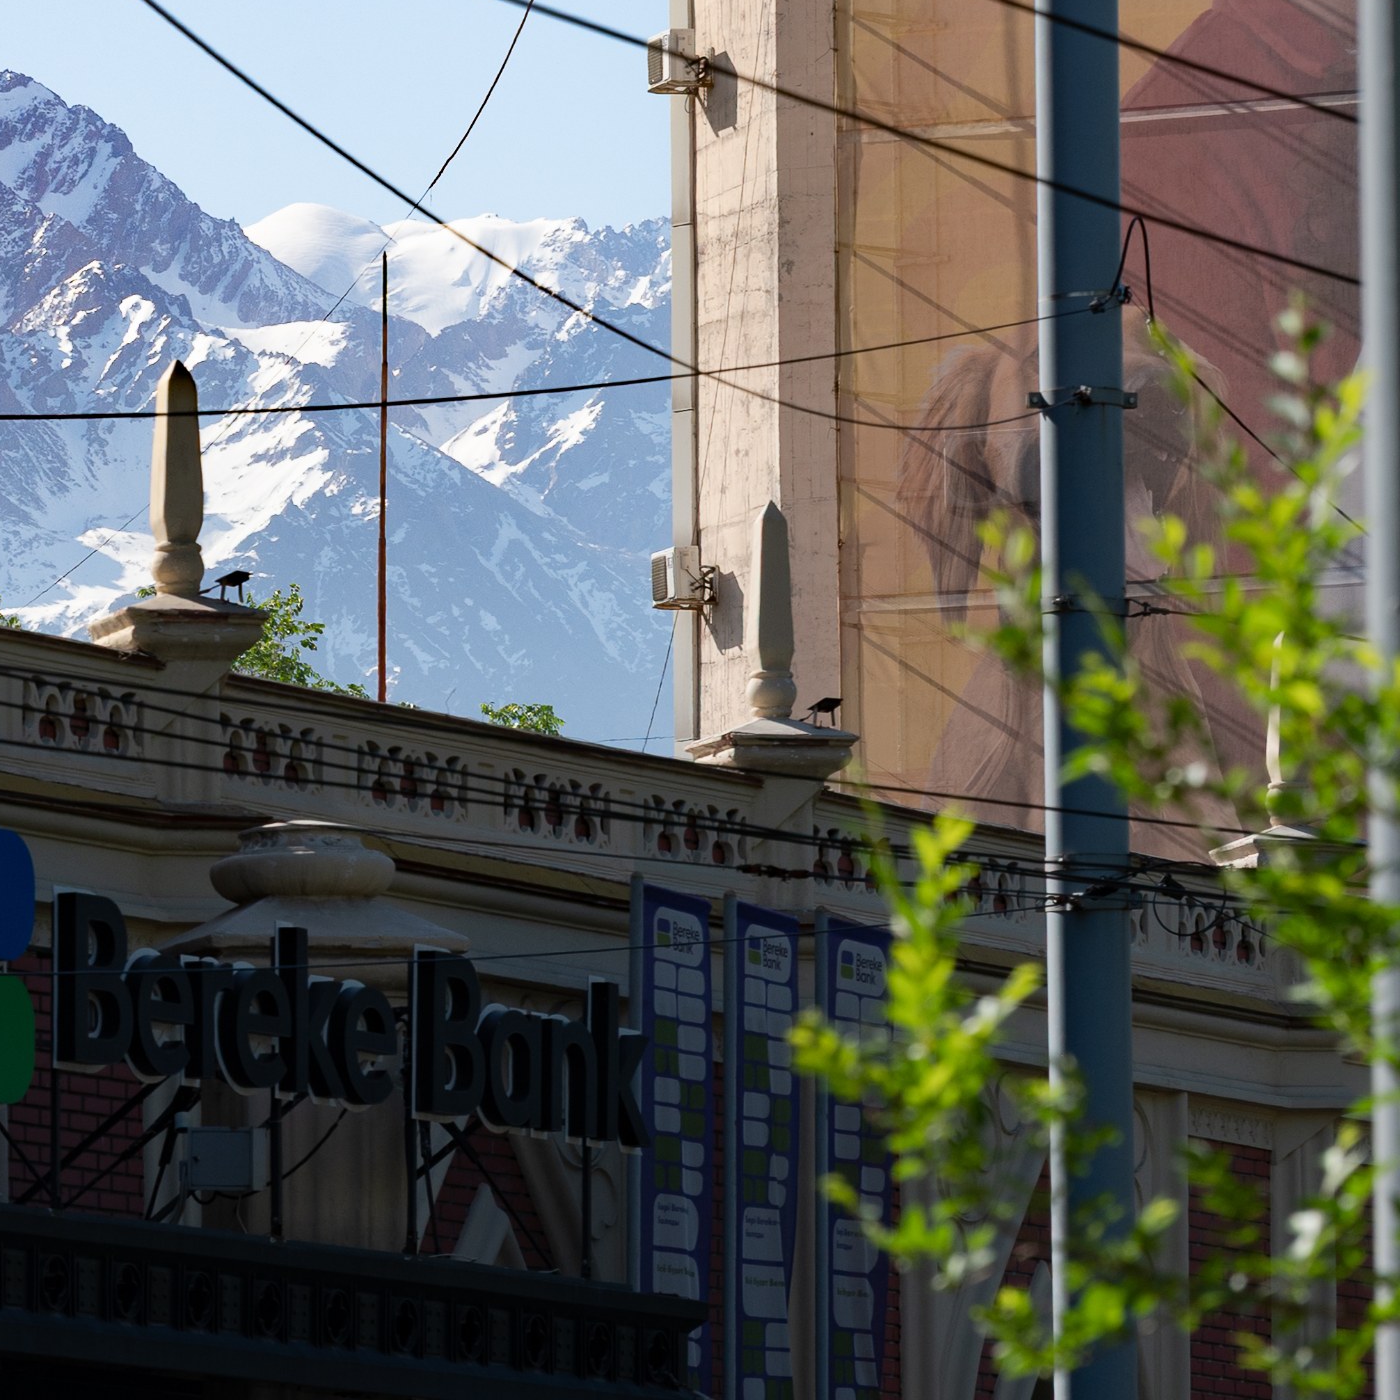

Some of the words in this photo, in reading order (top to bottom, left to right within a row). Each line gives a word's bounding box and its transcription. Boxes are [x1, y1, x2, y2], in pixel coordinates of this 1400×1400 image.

[673, 921, 700, 941] Bereke
[673, 936, 694, 955] Bank
[763, 937, 788, 958] Bereke
[763, 953, 782, 971] Bank
[856, 953, 883, 972] Bereke
[856, 968, 877, 986] Bank
[53, 886, 397, 1112] Bereke
[412, 944, 650, 1156] Bank
